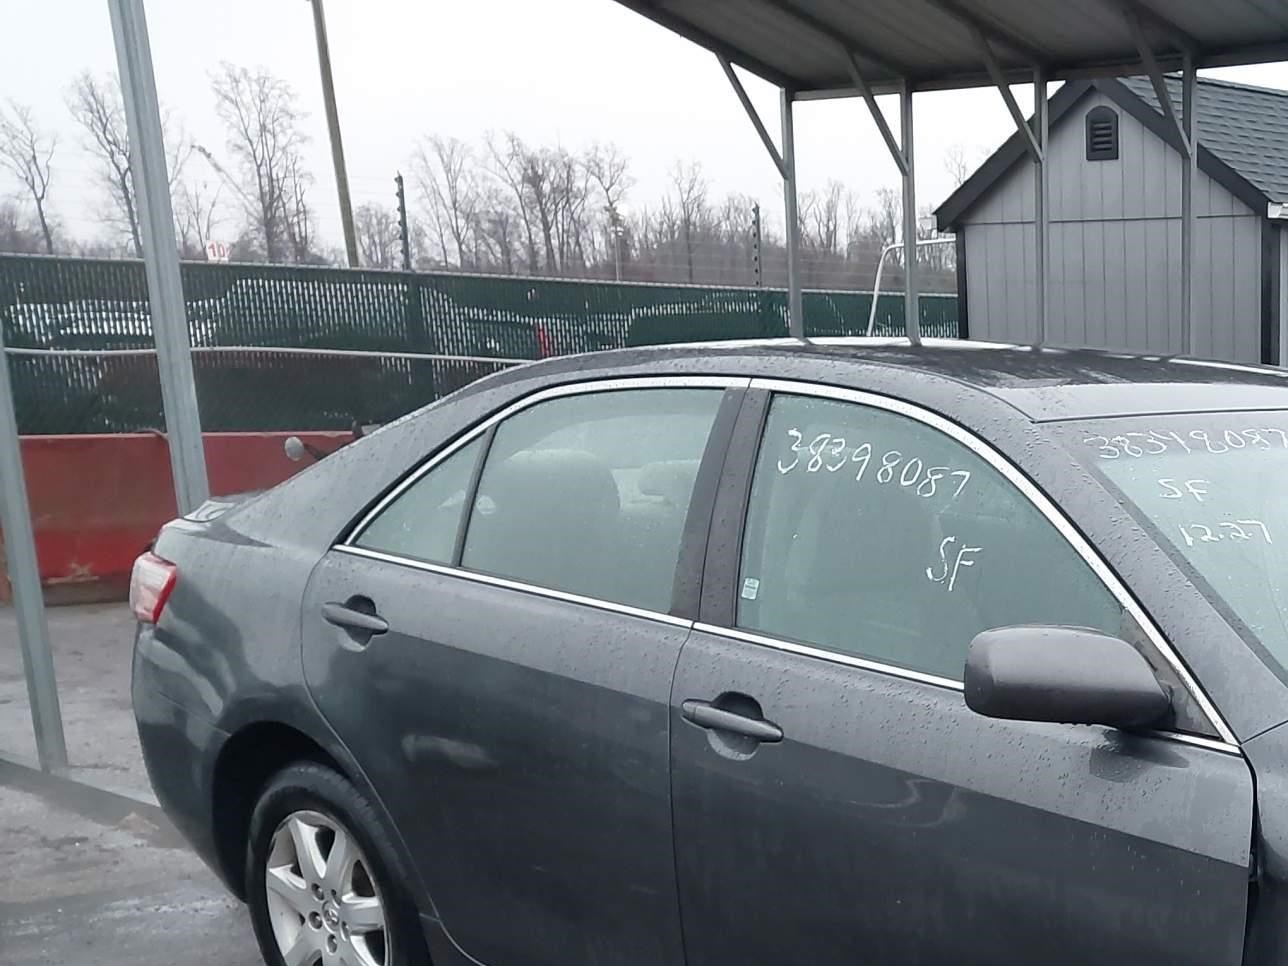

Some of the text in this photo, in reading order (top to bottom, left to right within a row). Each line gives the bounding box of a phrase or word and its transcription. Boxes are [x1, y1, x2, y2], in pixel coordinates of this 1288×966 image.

[777, 427, 971, 498] 38398087
[1157, 478, 1211, 502] SF
[925, 535, 984, 592] SF
